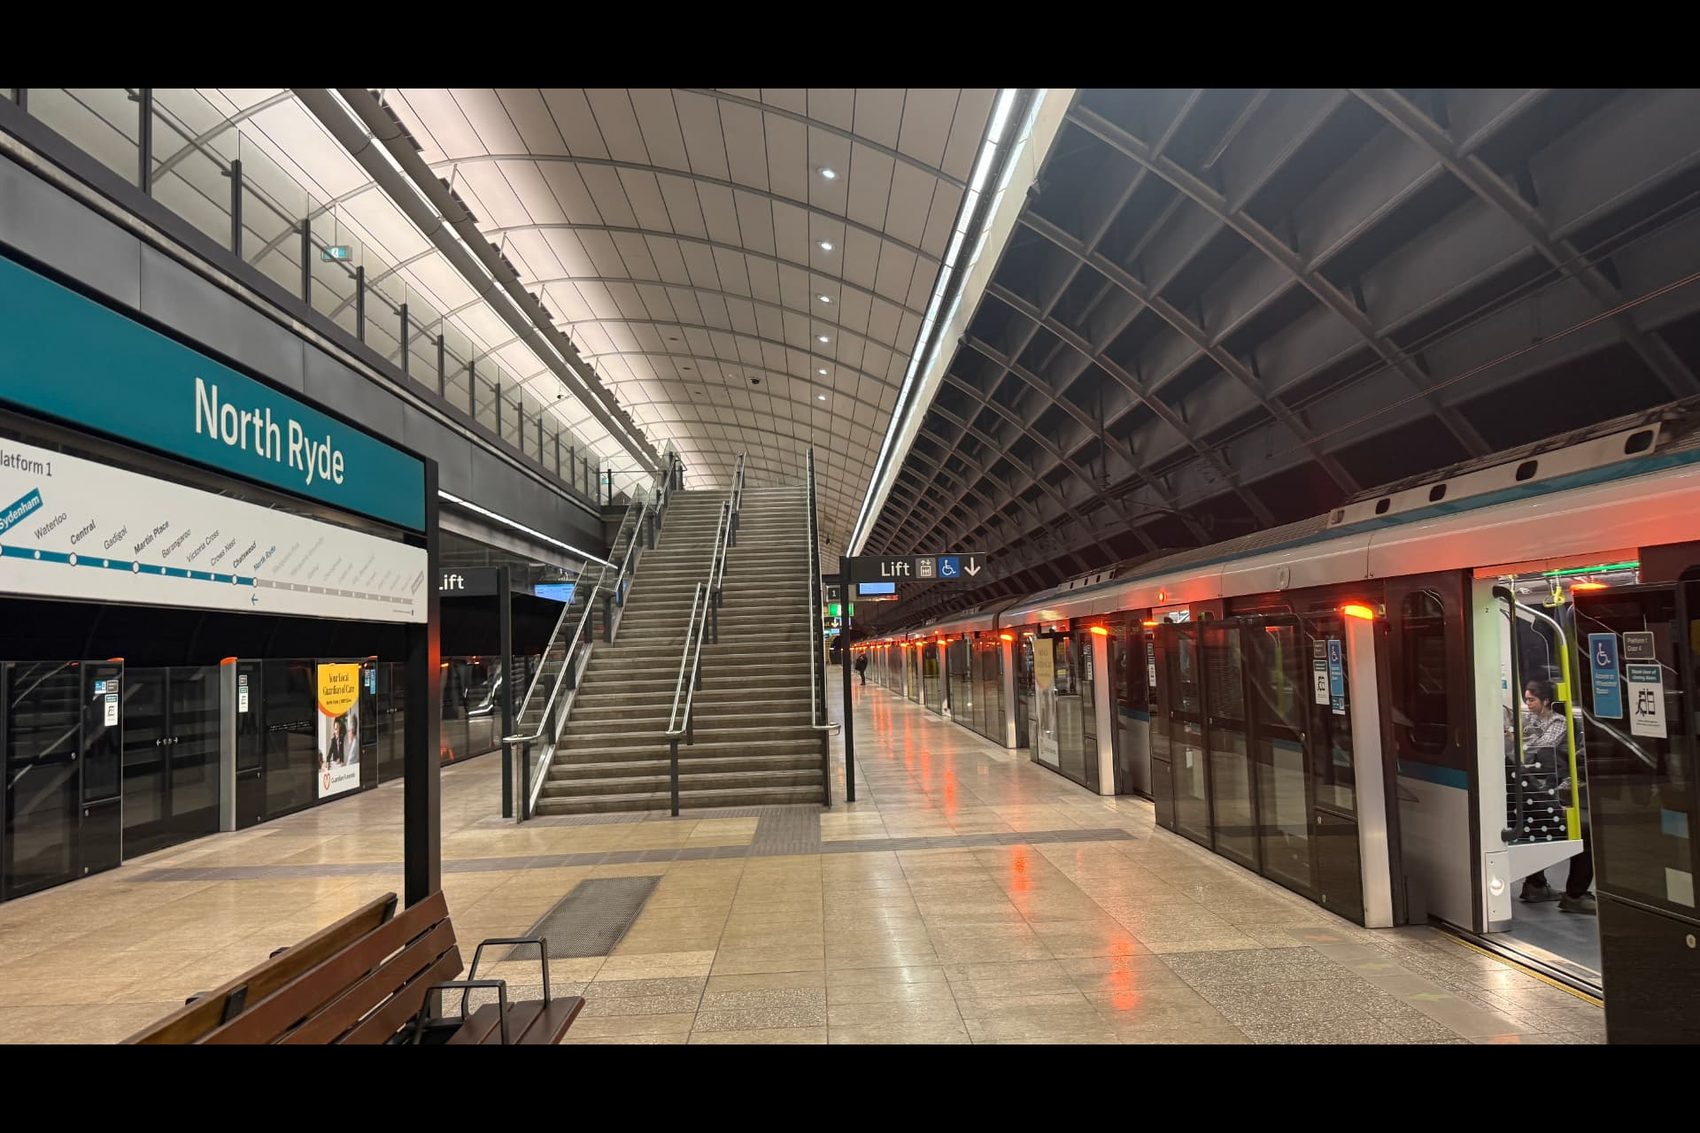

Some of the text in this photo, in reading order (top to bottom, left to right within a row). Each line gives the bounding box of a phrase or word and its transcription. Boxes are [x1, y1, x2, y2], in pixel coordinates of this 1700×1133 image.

[195, 377, 344, 486] North Ryde
[0, 449, 52, 477] latform 1
[0, 496, 40, 530] Sydenham
[34, 512, 67, 540] Waterloo
[70, 519, 96, 545] Central
[103, 524, 128, 550] Gadigal
[133, 521, 169, 555] Martin Place
[161, 529, 191, 559] Barangaroo
[186, 529, 220, 563] Victoria Cross
[232, 540, 257, 569] Chatswood
[253, 555, 267, 571] North
[438, 573, 465, 591] ift
[881, 561, 910, 577] Lift
